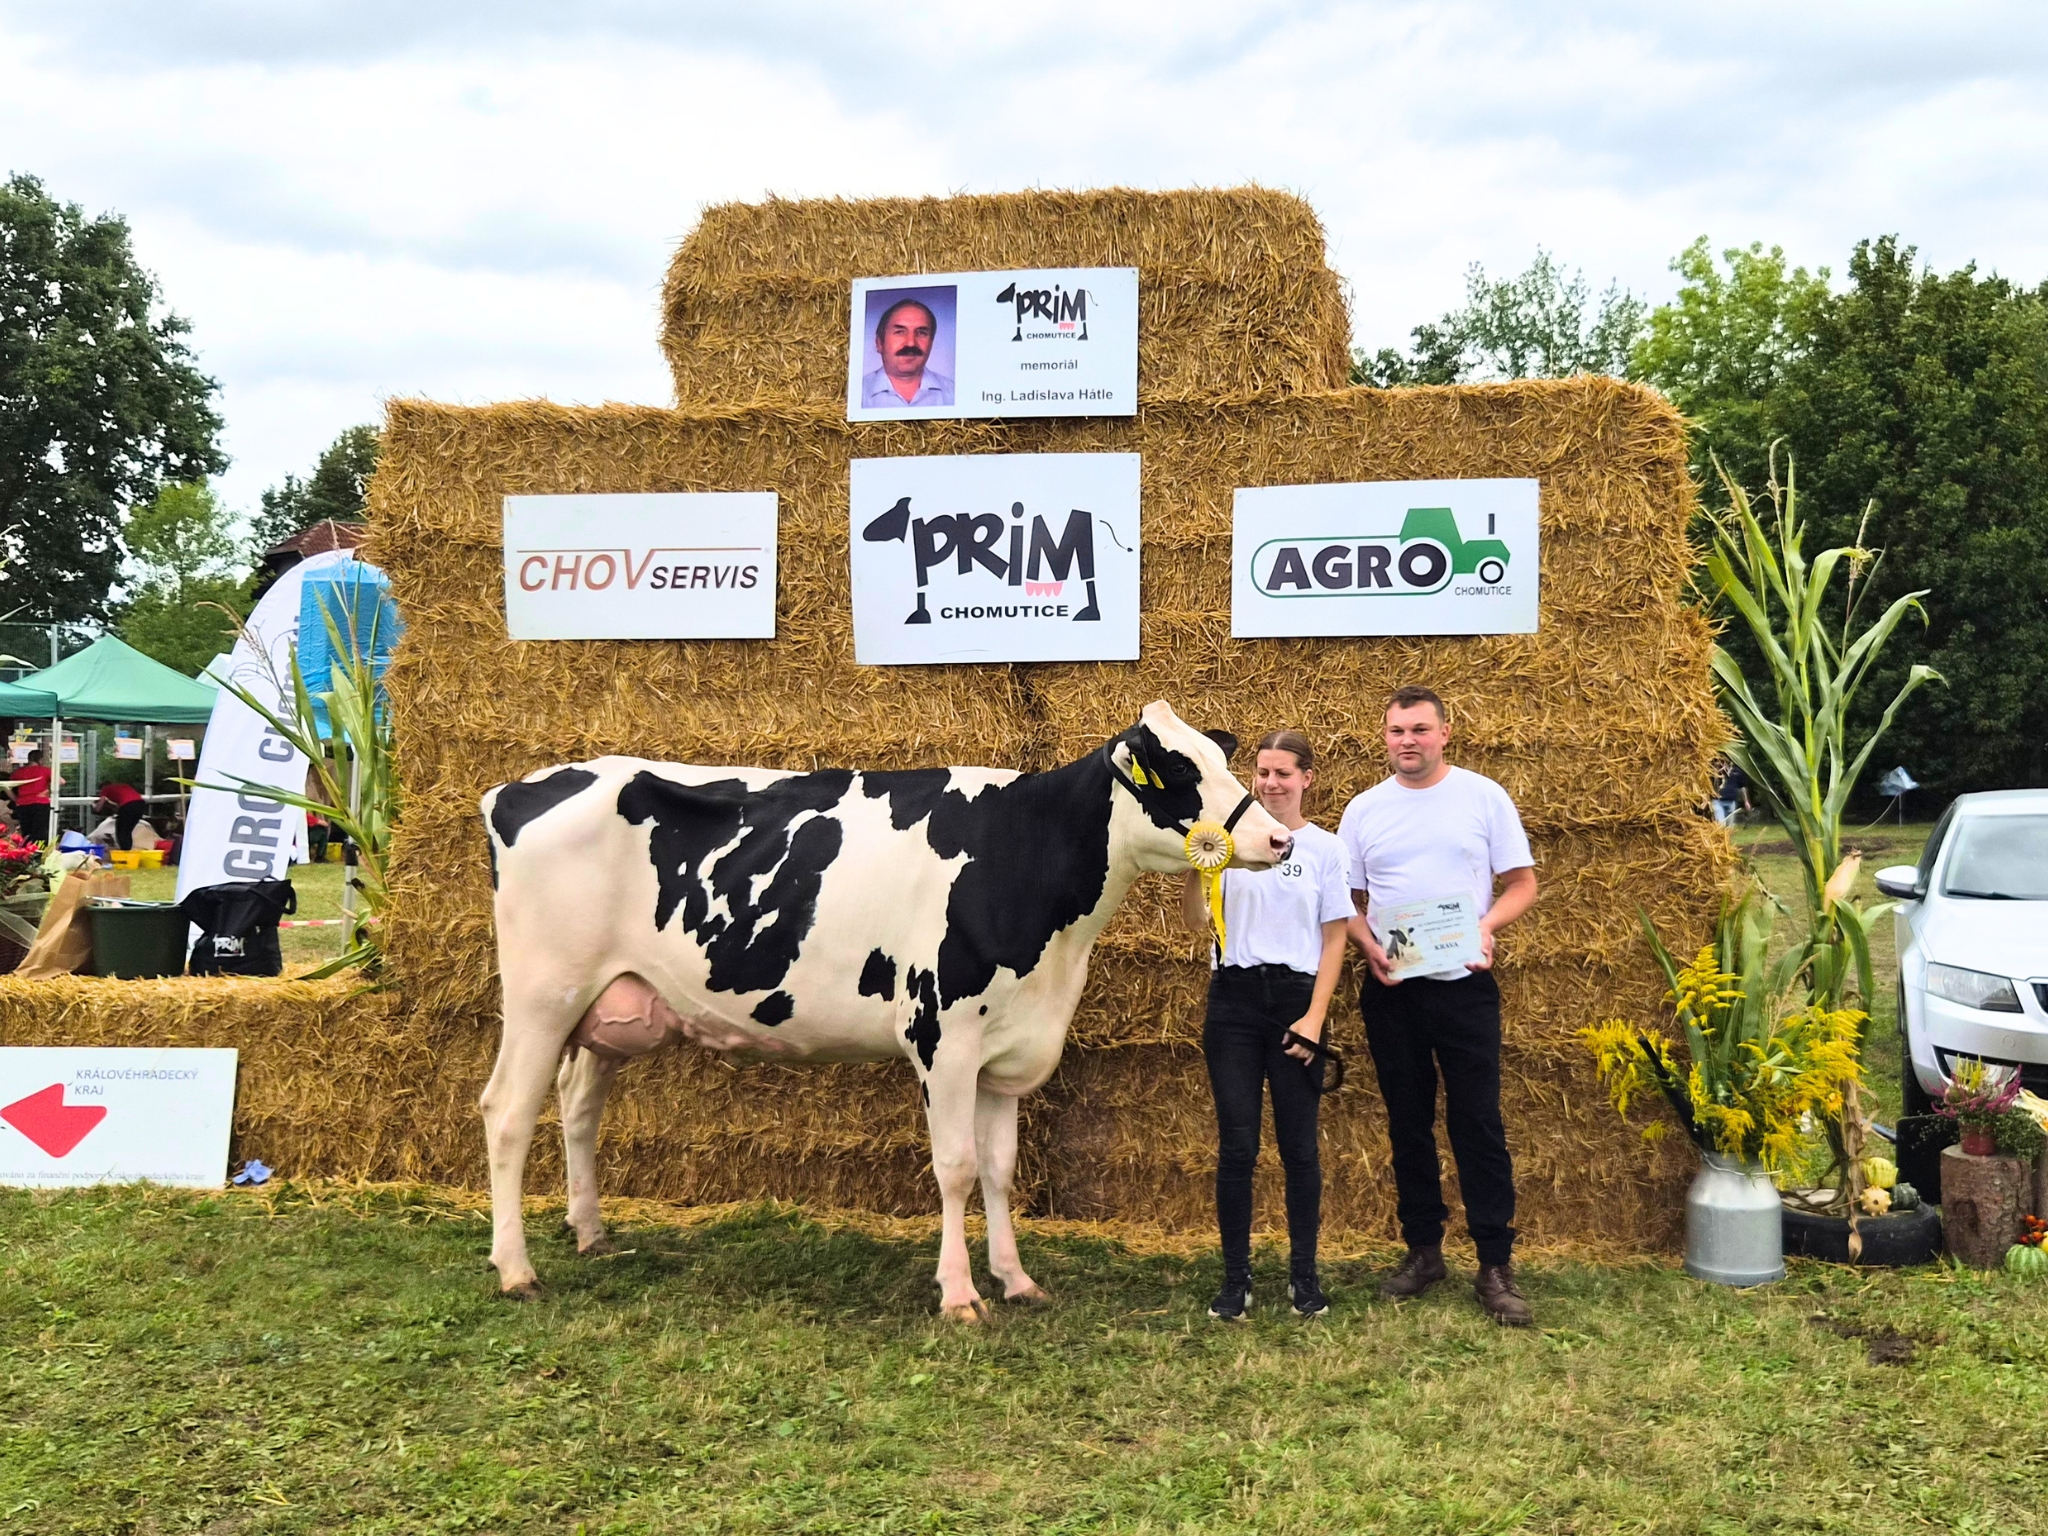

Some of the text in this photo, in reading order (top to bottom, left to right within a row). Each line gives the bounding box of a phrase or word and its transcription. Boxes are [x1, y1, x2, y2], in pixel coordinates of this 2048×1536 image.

[1026, 332, 1077, 340] CHOMUTICE
[1020, 360, 1078, 371] memoriál
[981, 388, 1114, 404] Ing. Ladislava Hátle
[1266, 543, 1447, 591] AGRO
[1454, 586, 1512, 596] CHOMUTICE
[940, 605, 1069, 619] CHOMUTICE
[1282, 863, 1302, 877] 39
[76, 1067, 200, 1081] KRÁLOVÉHRADECKÝ
[74, 1085, 104, 1096] KRAJ
